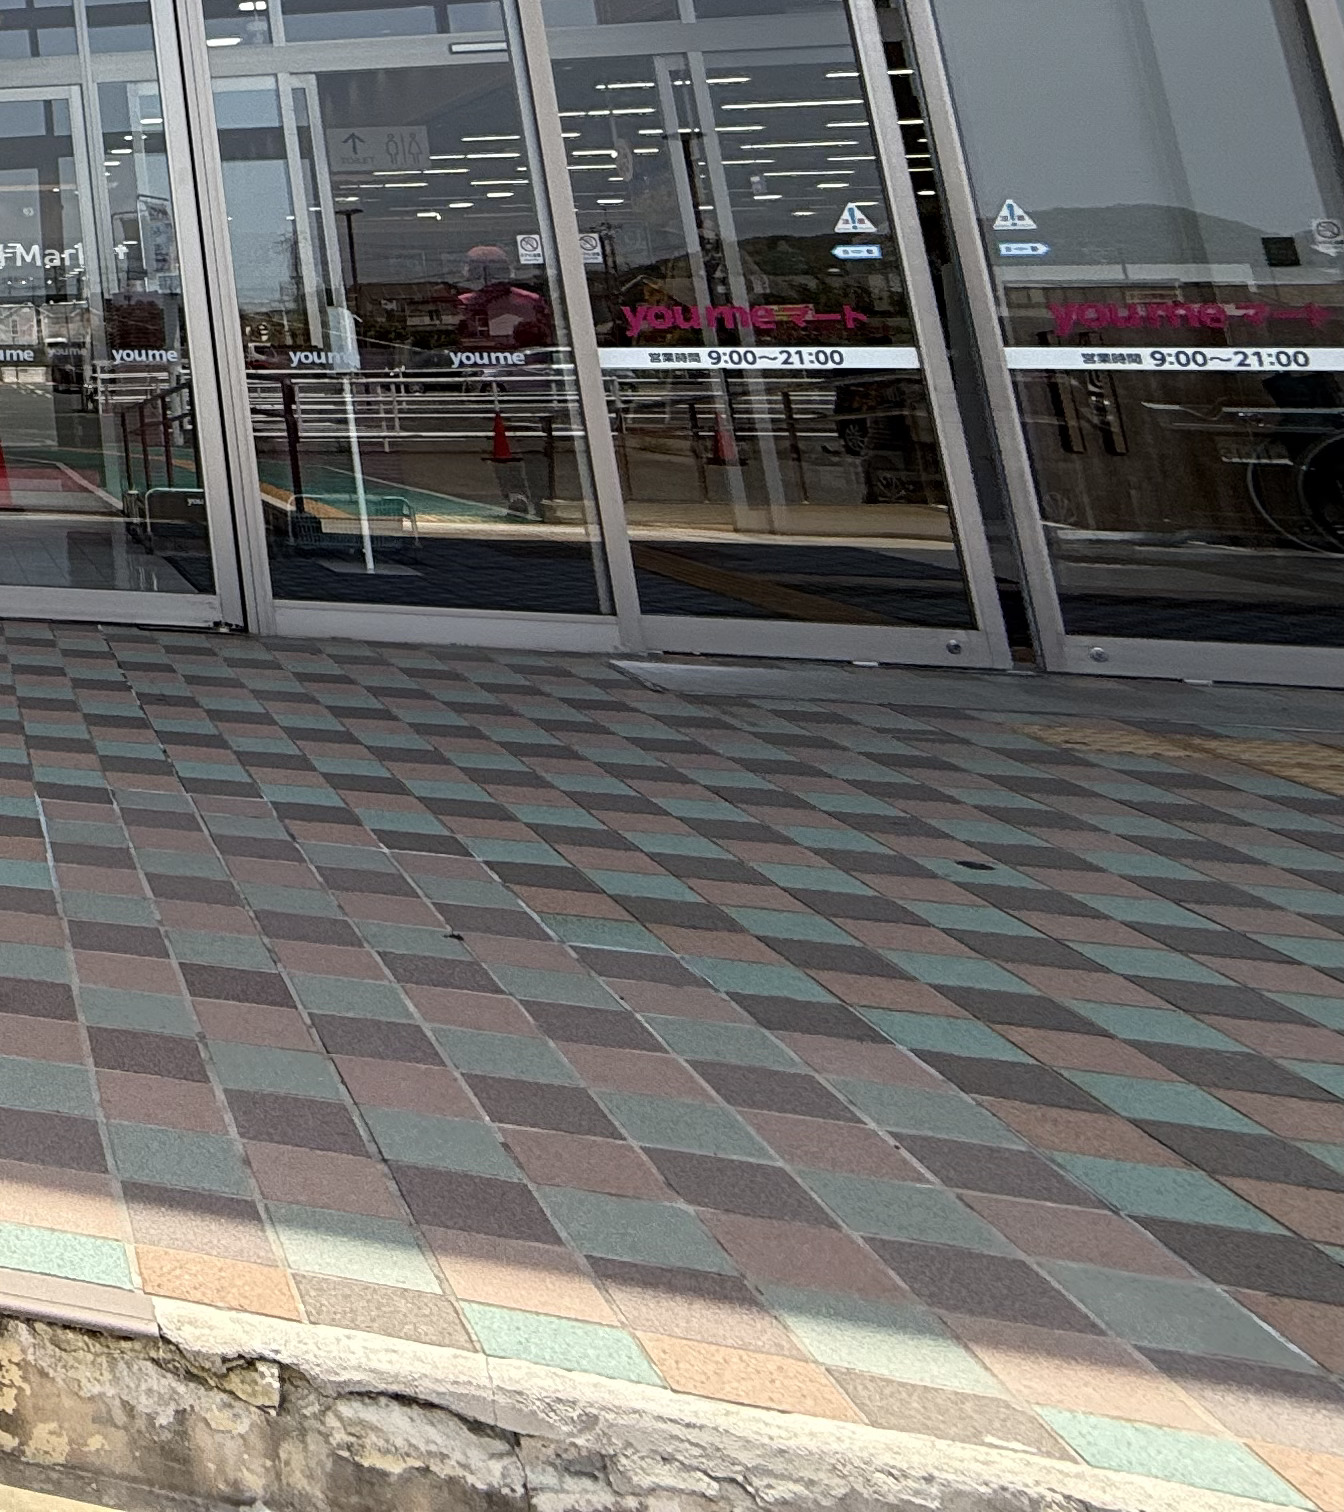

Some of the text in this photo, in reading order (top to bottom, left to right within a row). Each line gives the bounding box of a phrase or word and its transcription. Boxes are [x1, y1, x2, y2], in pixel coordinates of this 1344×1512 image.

[648, 352, 702, 365] 営業時間
[1080, 352, 1143, 365] 営業時間
